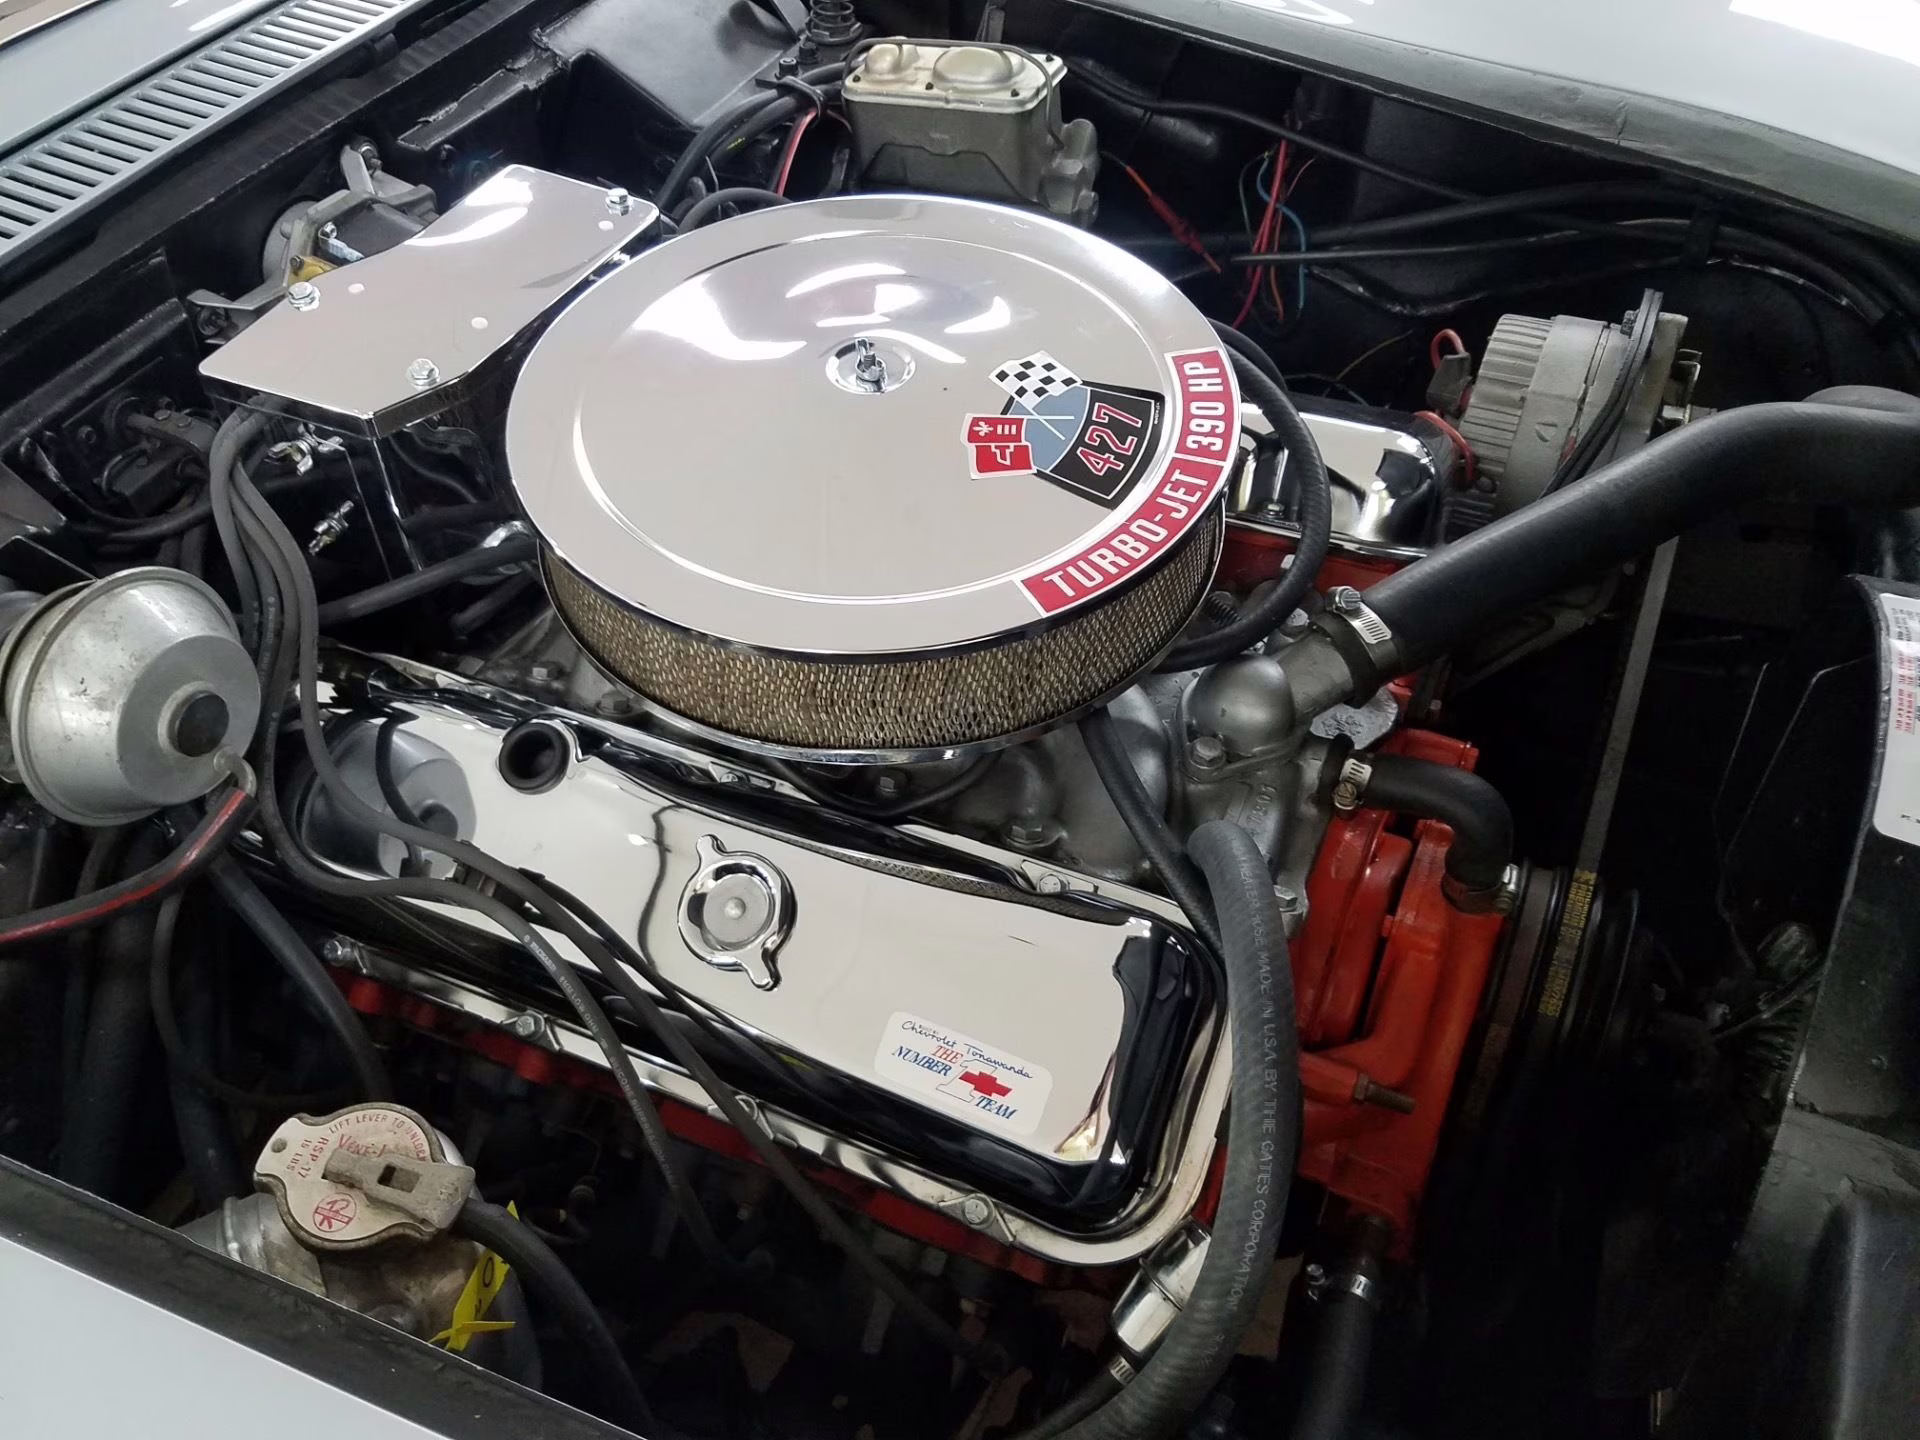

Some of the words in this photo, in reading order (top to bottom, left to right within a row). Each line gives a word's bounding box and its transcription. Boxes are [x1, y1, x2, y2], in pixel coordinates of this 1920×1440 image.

[1183, 360, 1224, 393] HP
[1076, 402, 1142, 476] 427
[1186, 401, 1226, 452] 390
[1042, 468, 1209, 598] TURBO-JET
[1256, 951, 1274, 995] MADE
[1262, 998, 1275, 1018] IN
[891, 1046, 953, 1077] NUMBER
[901, 1020, 957, 1048] Chevrolet
[964, 1043, 1033, 1079] Tonawanda
[930, 1045, 964, 1065] THE
[1263, 1069, 1278, 1093] BY
[329, 1118, 351, 1134] LIFT
[356, 1113, 387, 1124] LEVER
[391, 1117, 405, 1129] TO
[974, 1095, 1018, 1120] TEAM
[1261, 1098, 1277, 1133] THE
[1256, 1140, 1275, 1195] GATES
